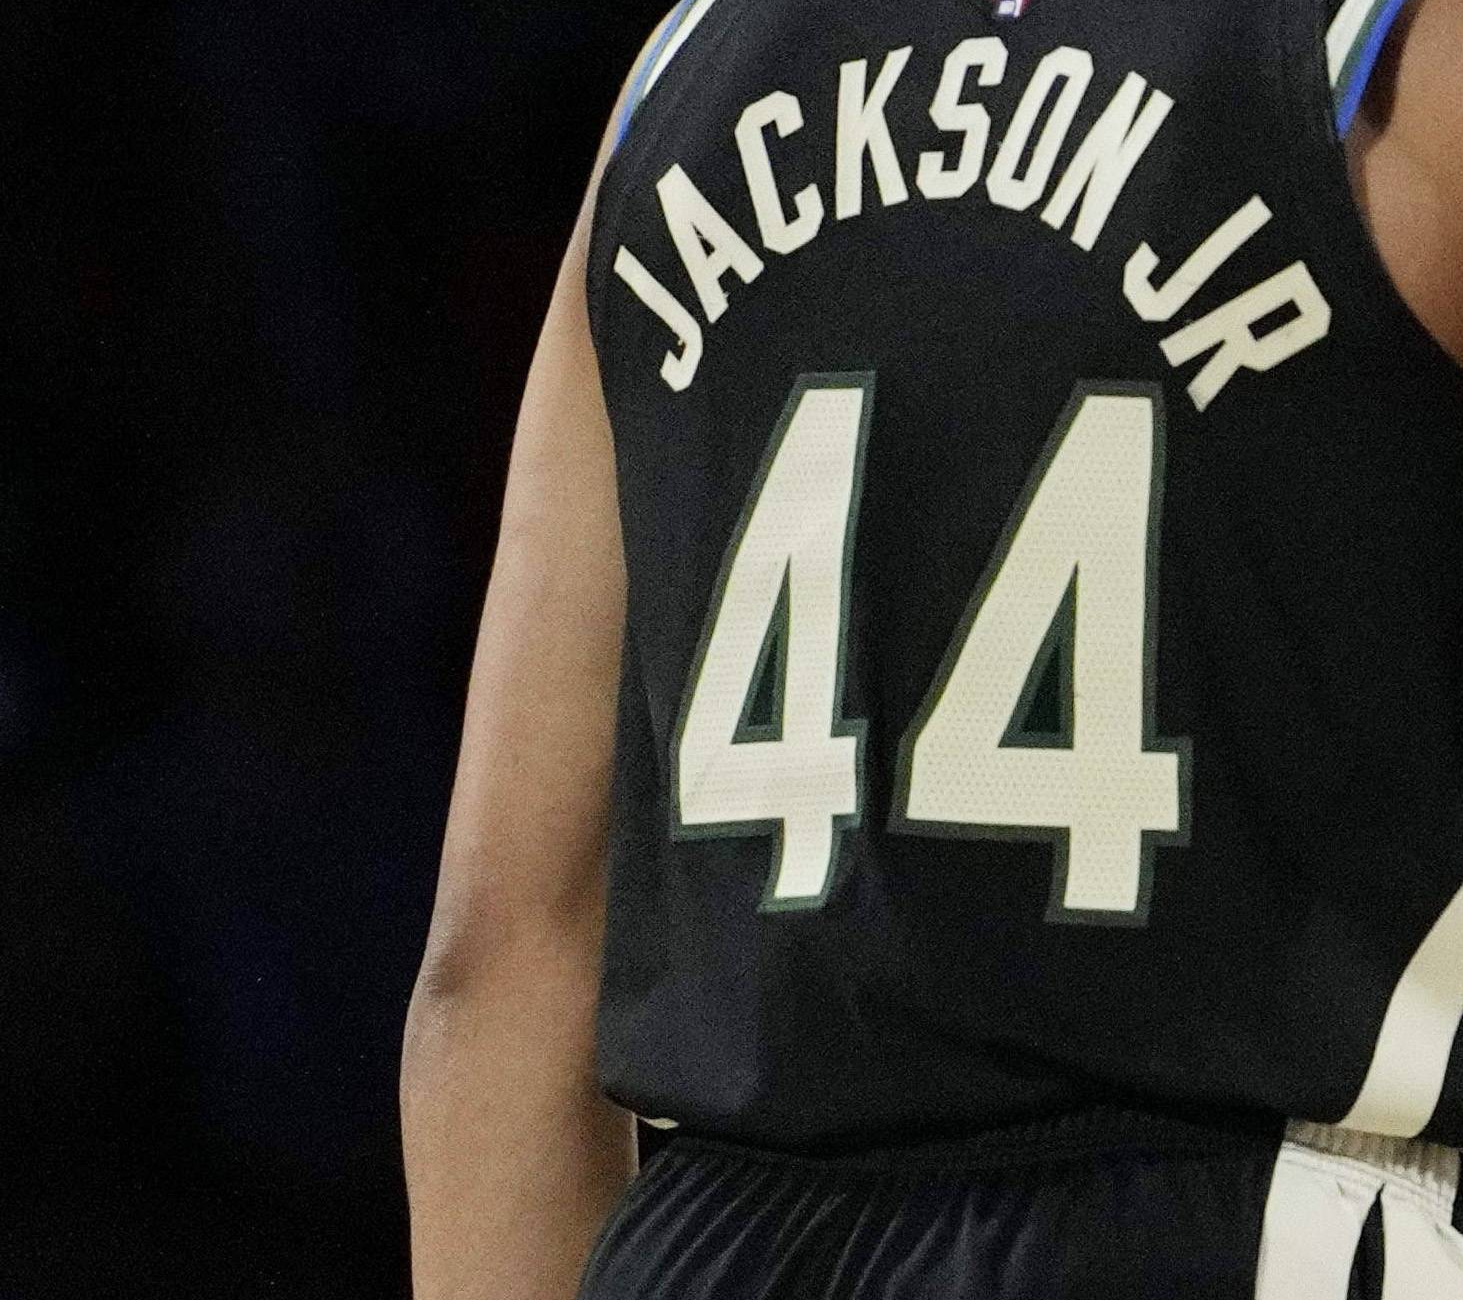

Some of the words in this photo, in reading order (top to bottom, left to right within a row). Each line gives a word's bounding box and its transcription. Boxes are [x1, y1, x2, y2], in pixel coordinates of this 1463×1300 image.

[614, 37, 1175, 392] JACKSON
[1123, 195, 1332, 411] JR
[671, 374, 1191, 924] 44
